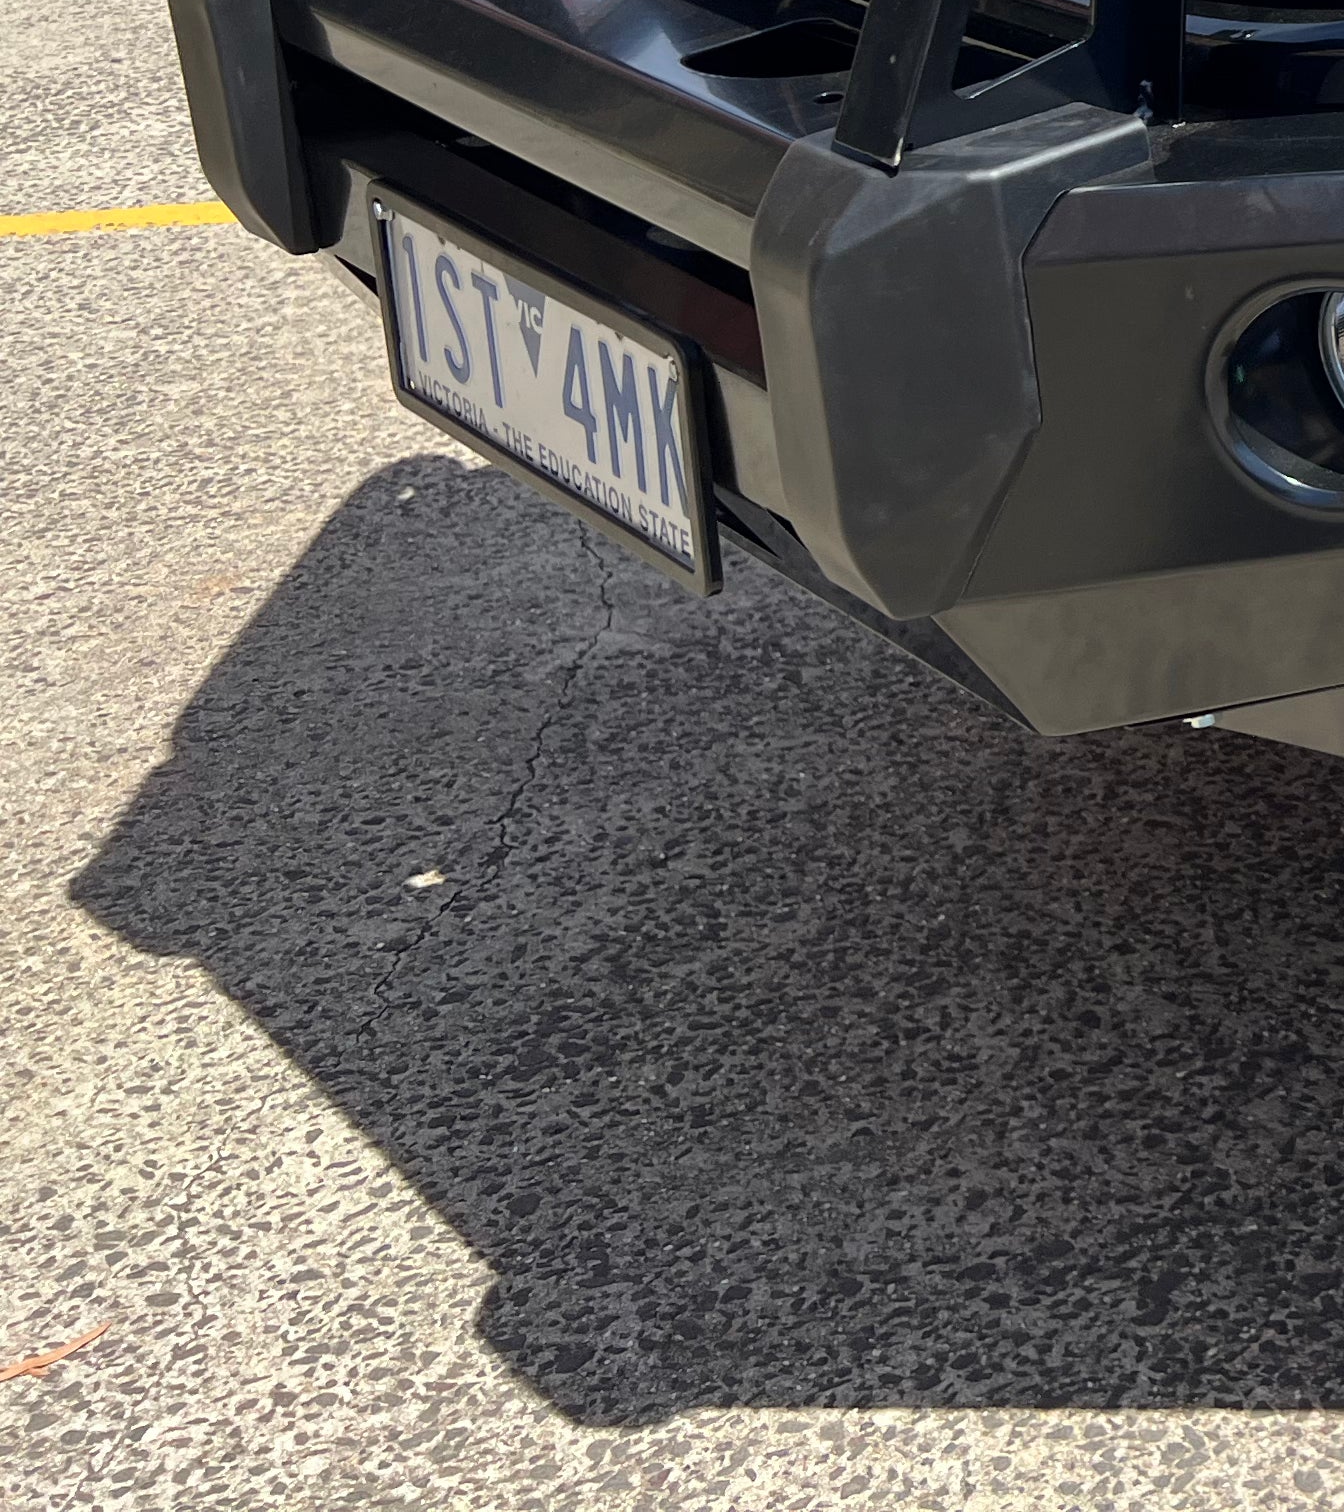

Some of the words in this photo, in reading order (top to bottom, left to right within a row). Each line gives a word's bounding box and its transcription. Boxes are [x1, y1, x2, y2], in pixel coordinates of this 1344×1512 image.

[402, 234, 505, 408] 1ST
[562, 324, 690, 515] 4MK
[512, 298, 544, 335] VIC
[419, 370, 489, 434] VICTORIA
[502, 422, 534, 460] THE
[539, 443, 633, 522] EDUCATION
[639, 504, 691, 556] STATE
